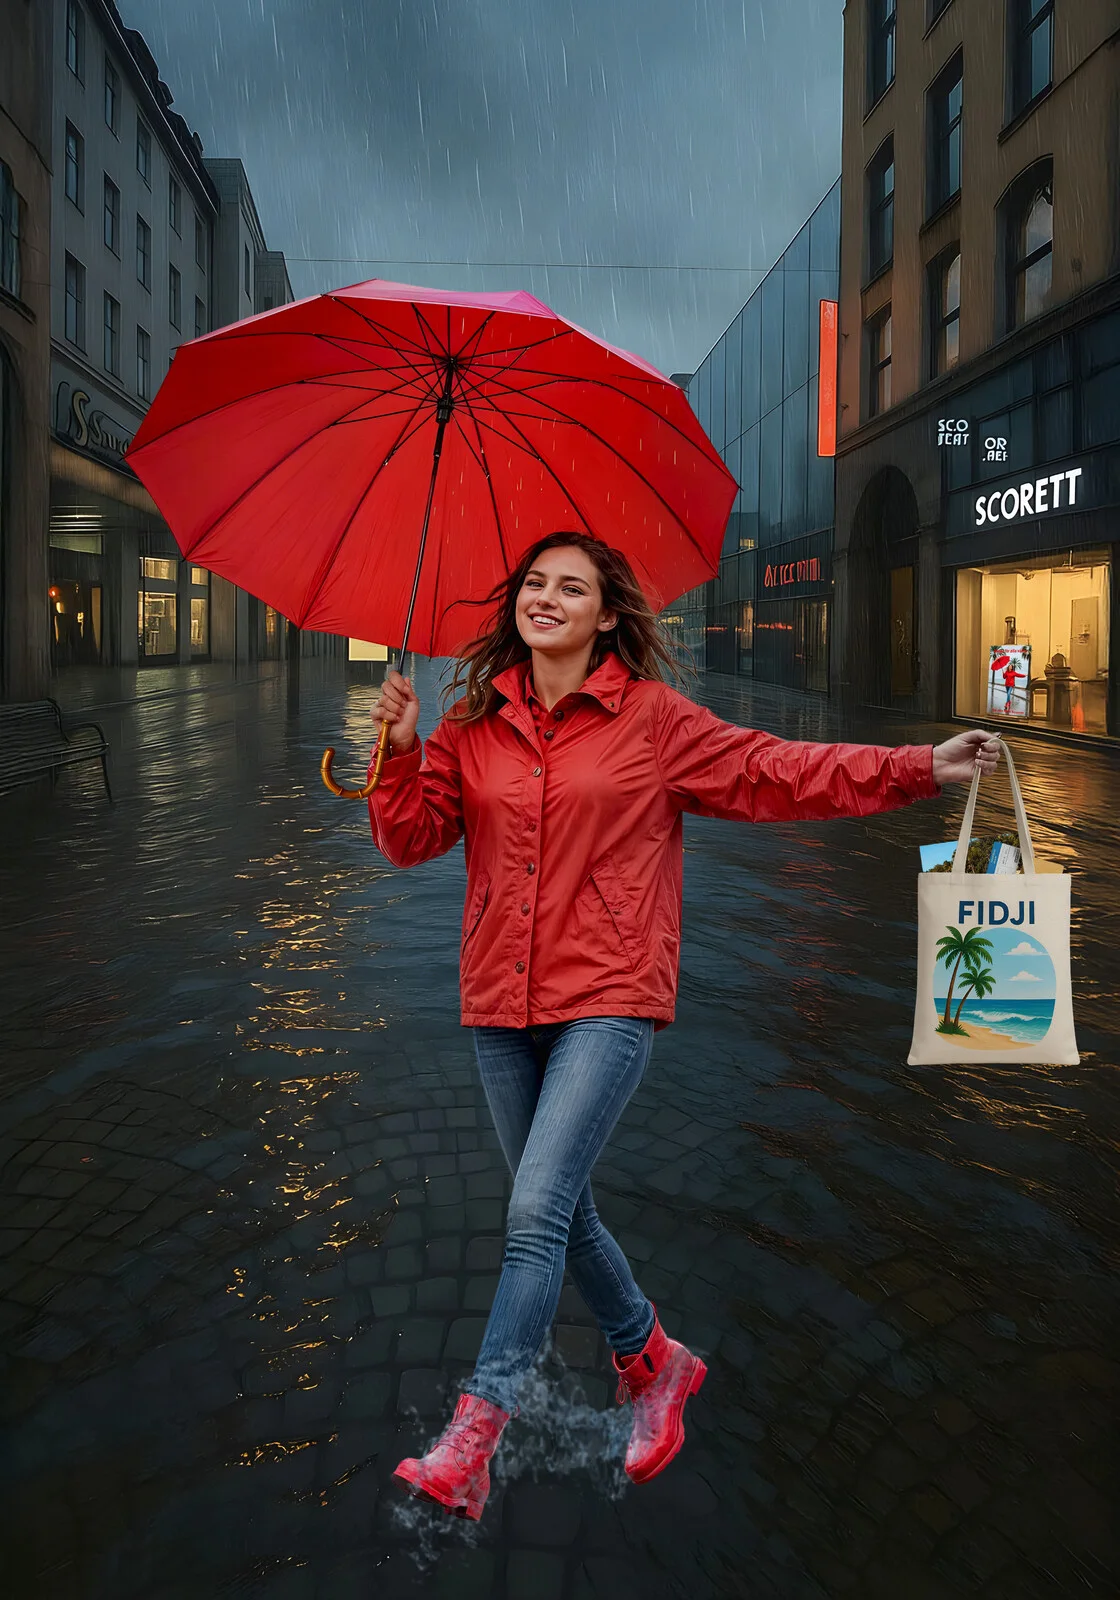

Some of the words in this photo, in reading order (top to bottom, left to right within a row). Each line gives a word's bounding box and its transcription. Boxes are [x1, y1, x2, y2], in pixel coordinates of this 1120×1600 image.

[984, 436, 1008, 450] OR
[975, 467, 1083, 526] SCORETT
[958, 900, 1035, 926] FIDJI
